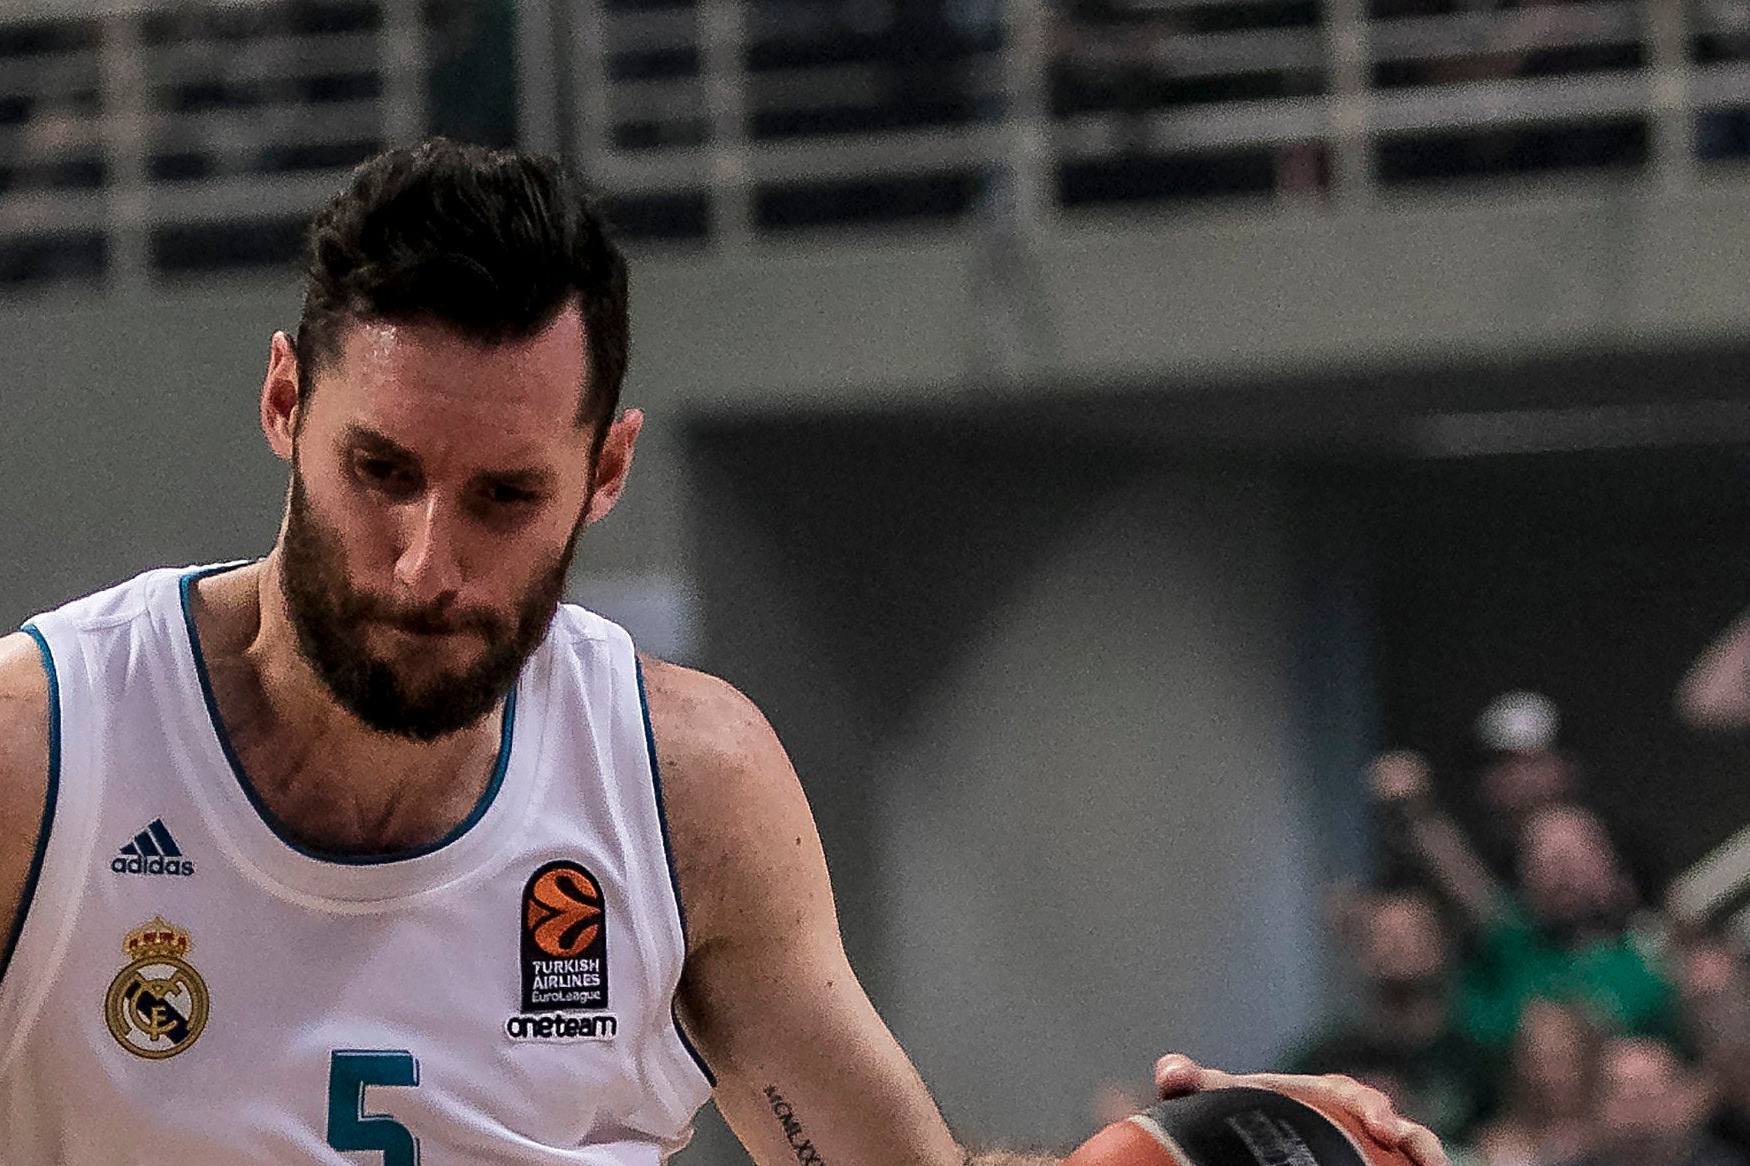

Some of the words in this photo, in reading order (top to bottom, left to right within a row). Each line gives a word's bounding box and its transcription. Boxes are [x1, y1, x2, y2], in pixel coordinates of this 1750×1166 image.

[111, 854, 195, 876] adidas
[532, 959, 600, 974] TURKISH
[533, 974, 601, 990] AIRLINES
[531, 990, 601, 1004] EuroLeague
